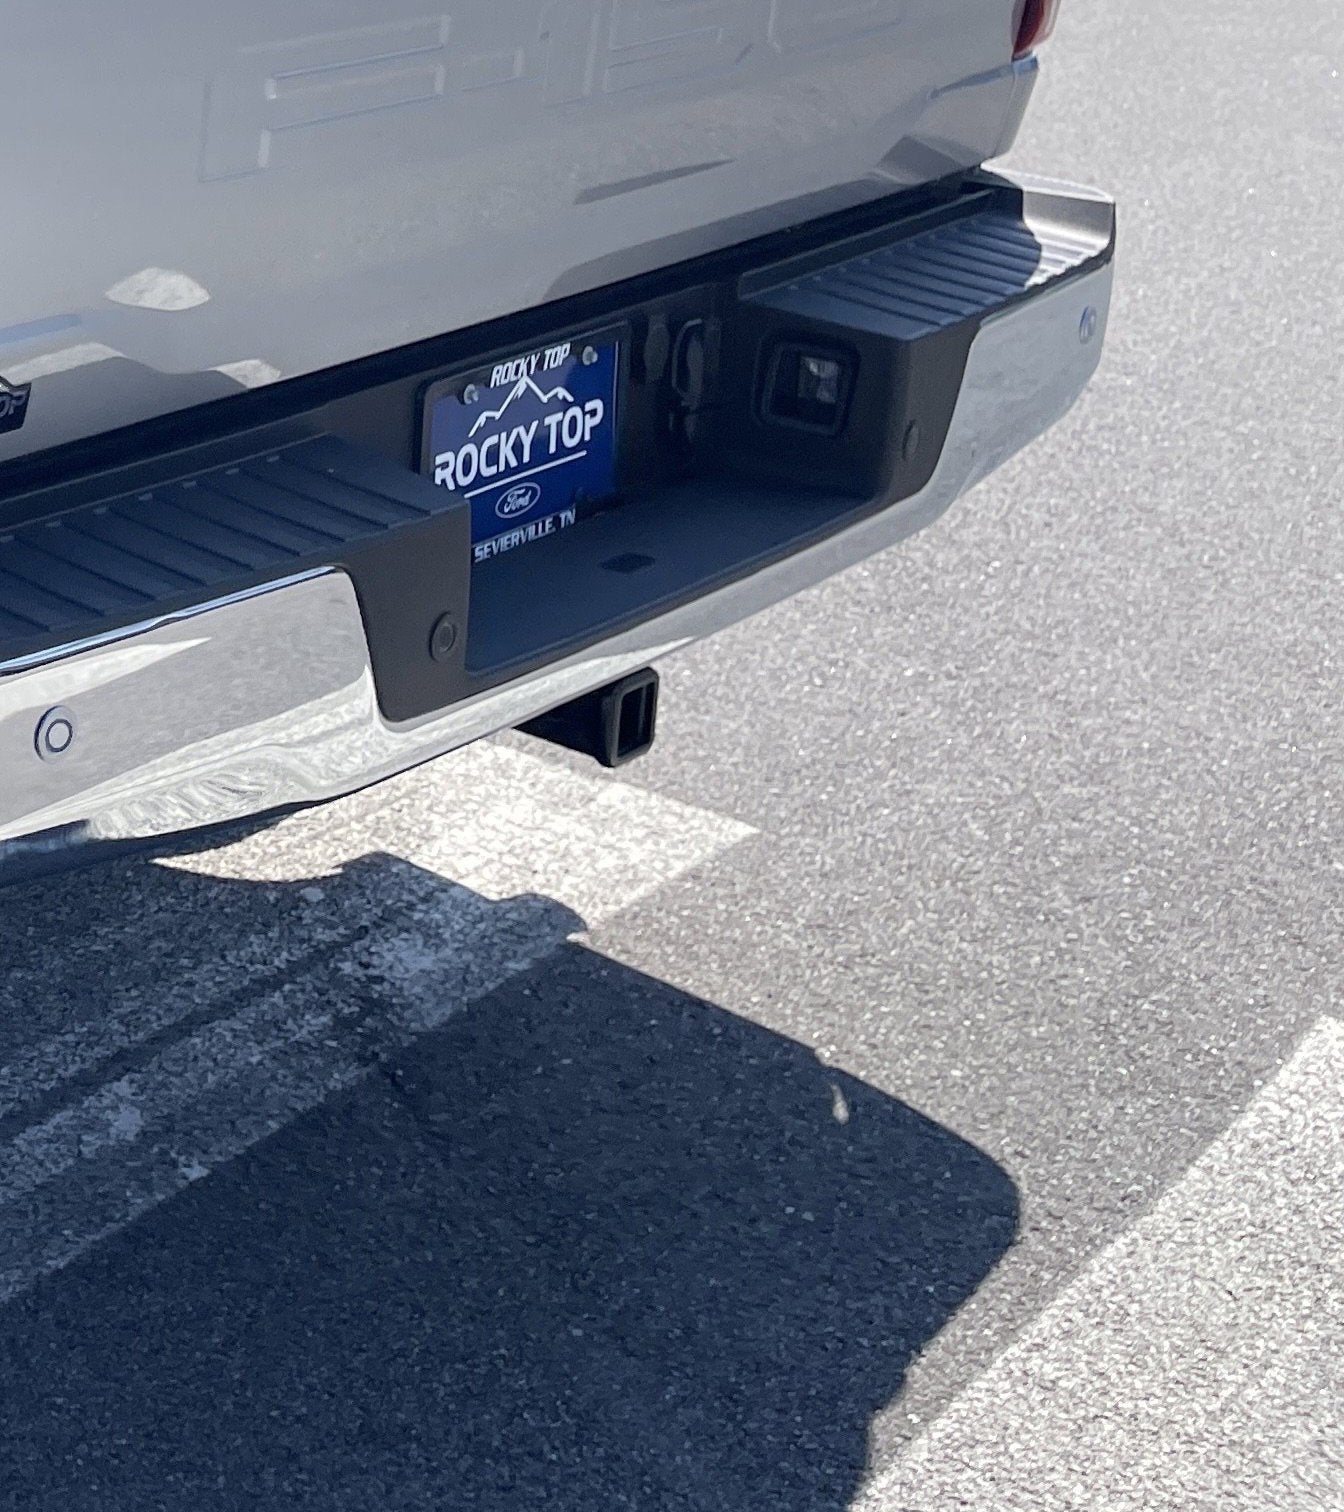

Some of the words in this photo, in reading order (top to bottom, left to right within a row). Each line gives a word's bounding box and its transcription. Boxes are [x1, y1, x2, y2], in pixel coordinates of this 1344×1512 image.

[490, 352, 541, 389] ROCKY
[543, 343, 571, 371] TOP
[434, 420, 538, 491] ROCKY
[544, 399, 604, 455] TOP
[503, 488, 532, 513] Ford
[559, 503, 576, 529] TN
